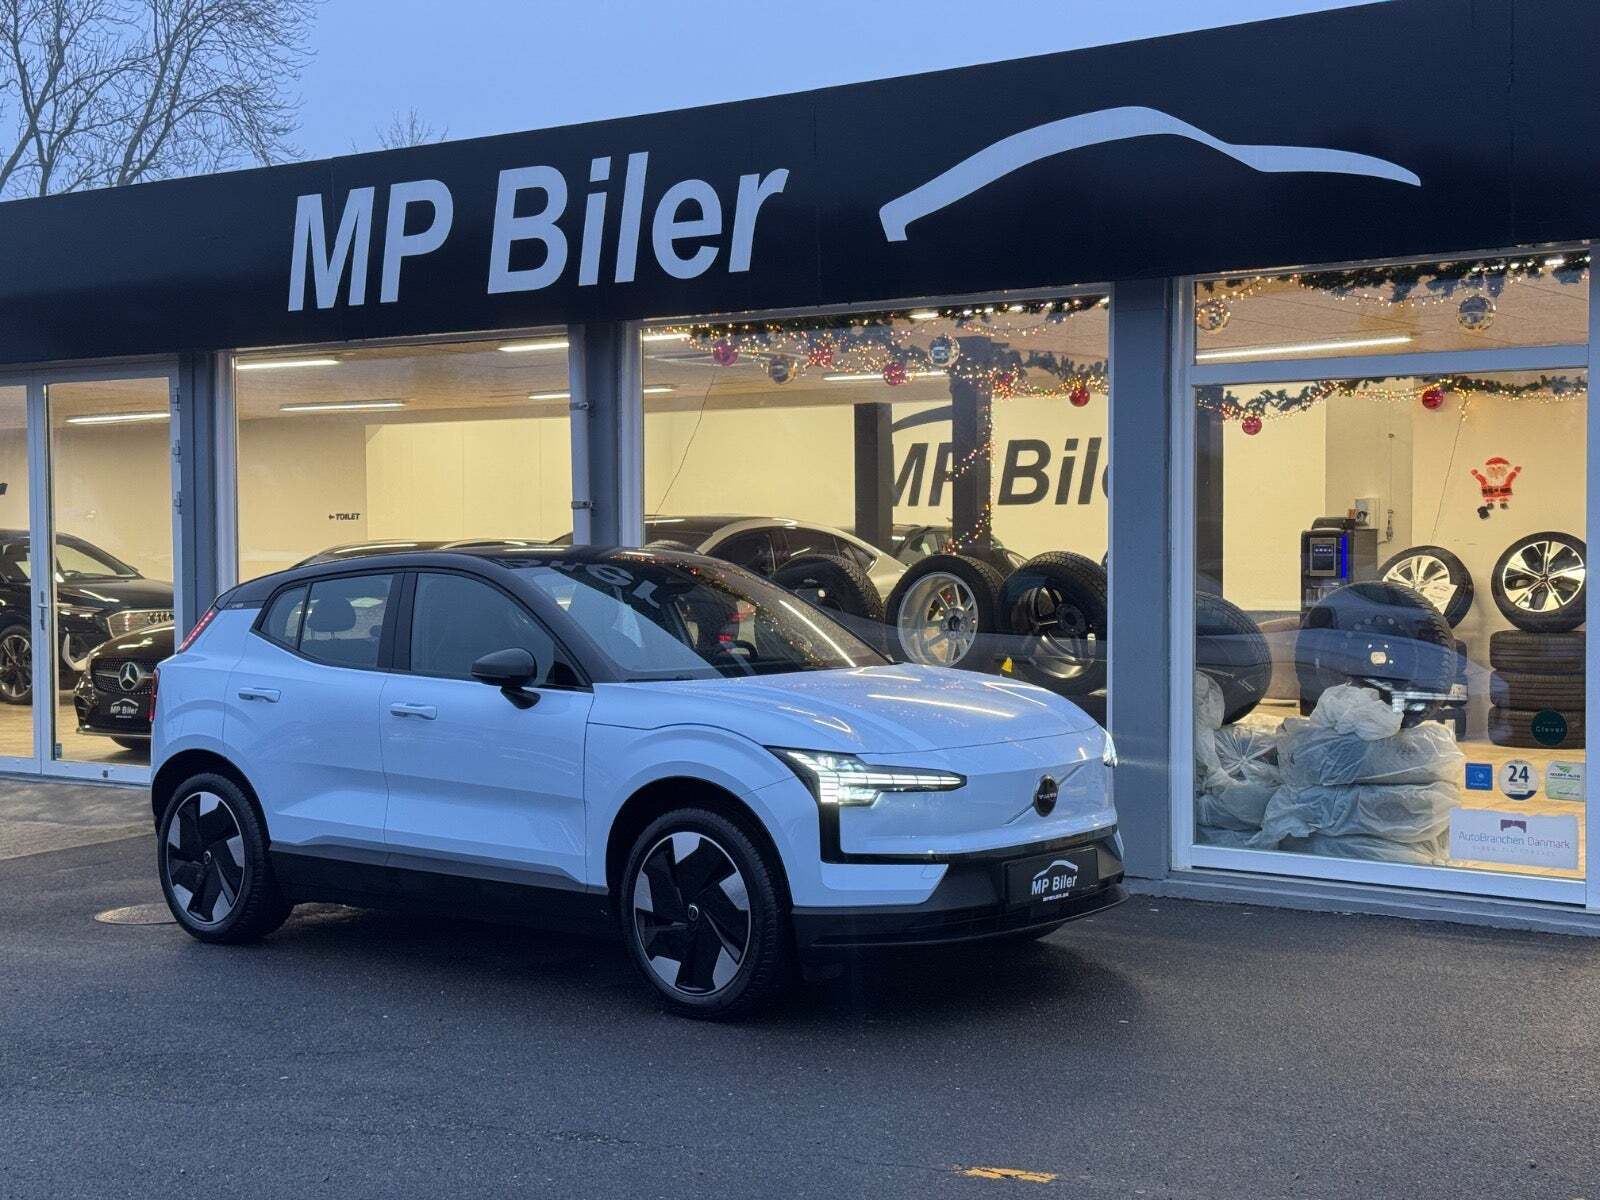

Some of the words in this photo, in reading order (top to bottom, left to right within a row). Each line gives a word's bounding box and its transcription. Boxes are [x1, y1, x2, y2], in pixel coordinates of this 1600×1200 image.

[288, 179, 454, 312] MP
[487, 151, 790, 294] Biler
[997, 437, 1109, 505] Bil
[335, 512, 361, 521] TOILET
[110, 705, 121, 714] MP
[121, 706, 138, 715] Biler
[1508, 765, 1530, 783] 24
[1458, 831, 1525, 845] AutoBranchen
[1527, 836, 1570, 849] Danmark
[1031, 879, 1050, 896] MP
[1052, 874, 1078, 891] Biler
